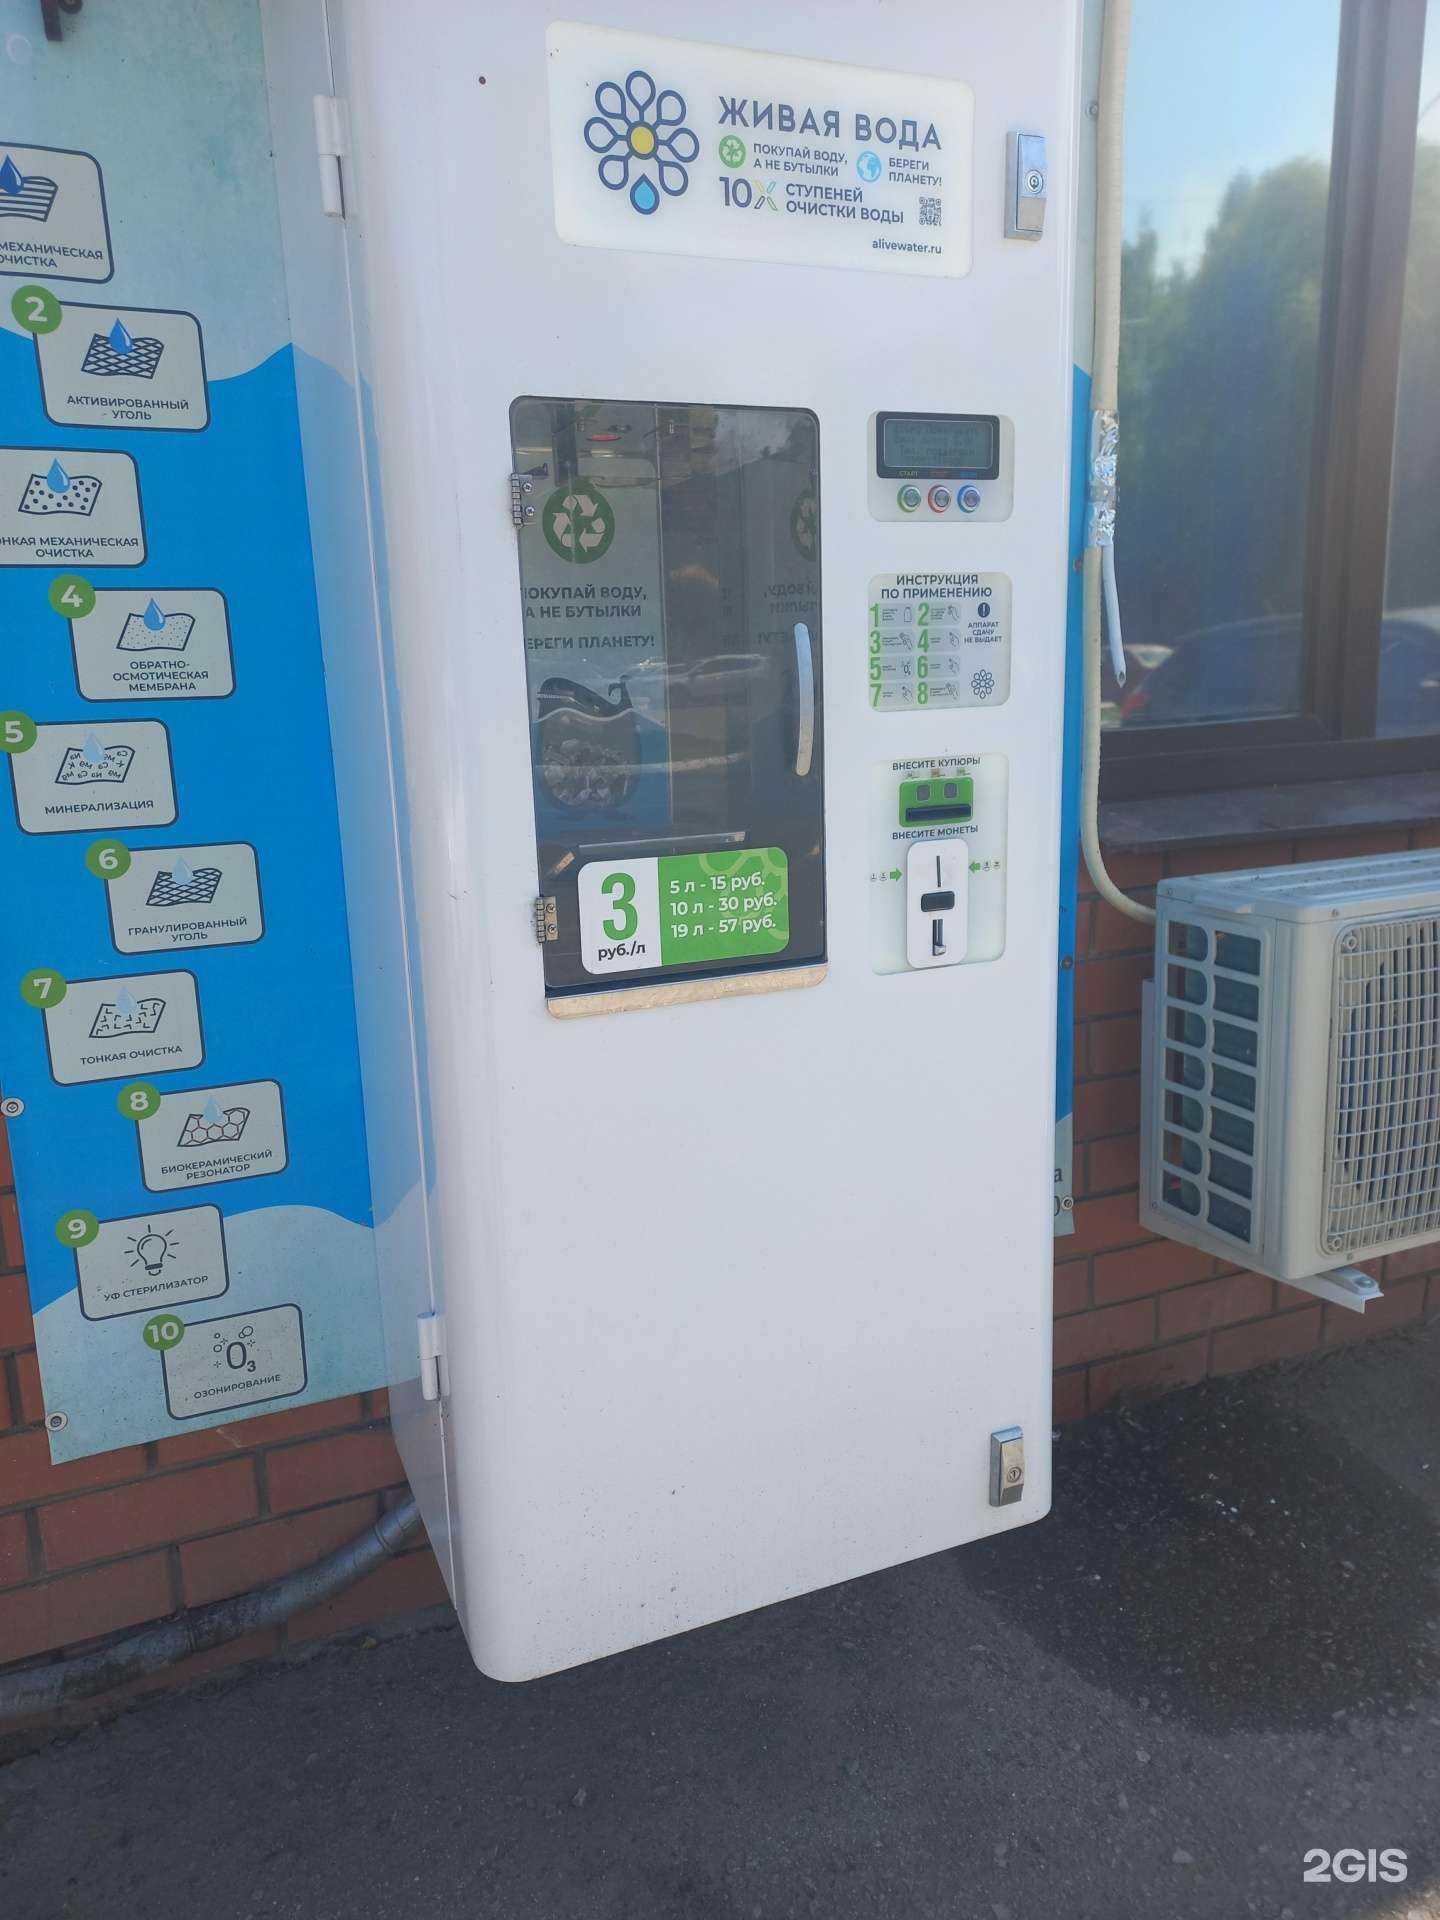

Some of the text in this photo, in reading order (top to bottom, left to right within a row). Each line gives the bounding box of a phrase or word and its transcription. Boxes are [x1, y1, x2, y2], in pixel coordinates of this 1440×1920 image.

[718, 96, 942, 151] ЖИВАЯ ВОДА
[753, 143, 848, 165] ПОКУПАЙ ВОДУ,
[888, 157, 929, 171] БЕРЕГИ
[753, 158, 839, 177] А НЕ БУТЫЛКИ
[888, 172, 942, 186] ПЛАНЕТУ!
[785, 182, 863, 203] СТУПЕНЕЙ
[785, 199, 905, 225] ОЧИСТКИ ВОДЫ
[0, 241, 103, 260] МЕХАНИЧЕСКАЯ
[871, 239, 942, 255] alivewater.ru
[25, 297, 47, 323] 2
[67, 395, 190, 410] АКТИВИРОВАННЫЙ
[112, 409, 152, 420] УГОЛЬ
[0, 537, 139, 547] НКАЯ МЕХАНИЧЕСКАЯ
[35, 548, 94, 558] ОЧИСТКА
[896, 574, 979, 586] ИНСТРУКЦИЯ
[61, 585, 83, 608] 4
[600, 586, 648, 601] ВОДУ,
[881, 587, 992, 599] ПО ПРИМЕНЕНИЮ
[526, 605, 641, 618] А НЕ БУТЫЛКИ
[870, 603, 880, 627] 1
[918, 603, 929, 627] 2
[967, 621, 1000, 629] АППАРАТ
[527, 635, 655, 650] ЕРЕГИ ПЛАНЕТУ!
[870, 630, 880, 654] 3
[918, 629, 929, 653] 4
[130, 660, 190, 670] ОБРАТНО-
[870, 657, 881, 680] 5
[918, 655, 928, 679] 6
[112, 671, 208, 681] ОСМОТИЧЕСКАЯ
[129, 682, 196, 692] МЕМБРАНА
[870, 683, 881, 707] 7
[918, 682, 928, 704] 8
[5, 720, 24, 743] 5
[892, 757, 980, 771] ВНЕСИТЕ КУПЮРЫ
[45, 800, 154, 815] МИНЕРАЛИЗАЦИЯ
[892, 826, 979, 840] ВНЕСИТЕ МОНЕТЫ
[98, 848, 119, 870] 6
[670, 880, 680, 894] 5
[684, 880, 695, 892] л
[710, 876, 726, 890] 15
[731, 871, 765, 892] руб.
[601, 872, 638, 941] 3
[670, 902, 688, 916] 10
[692, 902, 703, 914] л
[718, 897, 739, 911] 30
[743, 892, 777, 912] руб.
[128, 916, 247, 936] ГРАНУЛИРОВАННЫЙ
[671, 924, 687, 938] 19
[693, 924, 704, 936] л
[719, 918, 738, 933] 57
[742, 914, 776, 934] руб.
[171, 932, 208, 943] УГОЛЬ
[598, 941, 646, 961] руб./л
[33, 977, 53, 999] 7
[80, 1045, 183, 1065] ТОНКАЯ ОЧИСТКА
[130, 1091, 149, 1111] 8
[161, 1149, 273, 1175] БИОКЕРАМИЧЕСКИЙ
[186, 1163, 250, 1180] РЕЗОНАТОР
[67, 1219, 87, 1240] 9
[104, 1275, 209, 1302] УФ СТЕРИЛИЗАТОР
[148, 1321, 179, 1344] 10
[194, 1374, 281, 1399] ОЗОНИРОВАНИЕ
